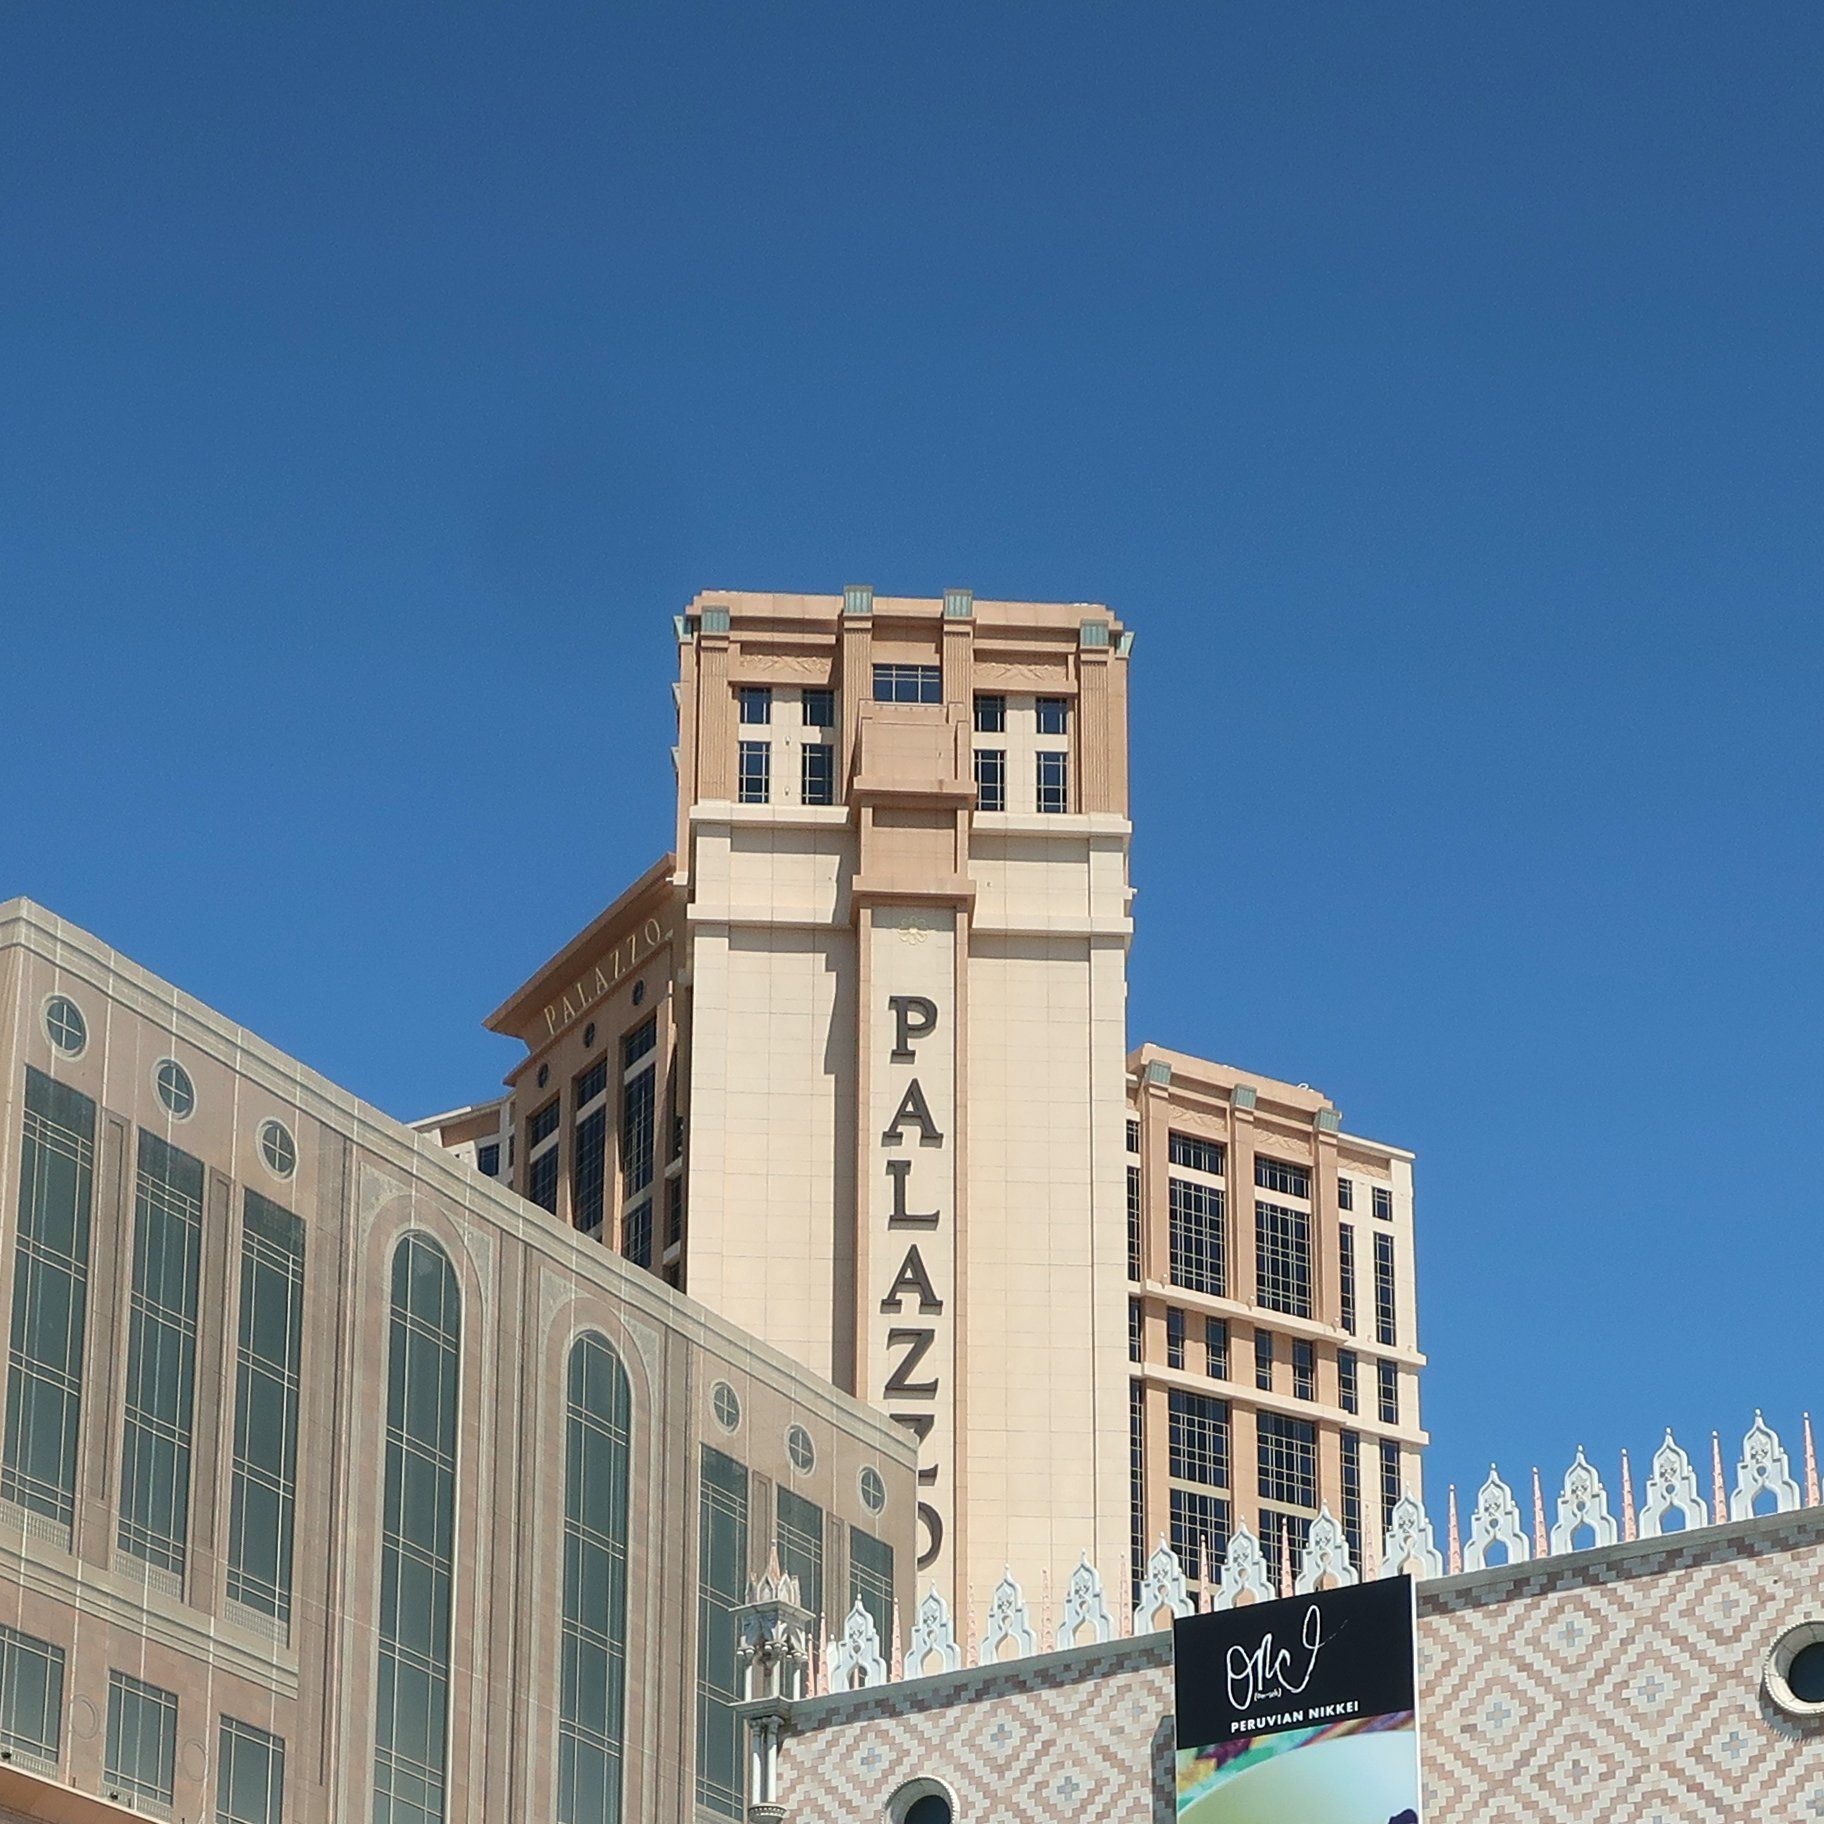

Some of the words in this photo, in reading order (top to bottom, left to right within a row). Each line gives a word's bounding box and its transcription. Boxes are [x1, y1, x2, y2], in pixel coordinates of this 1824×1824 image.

[543, 918, 661, 1036] PALAZZO
[1231, 1710, 1304, 1733] PERUVIAN
[1308, 1700, 1360, 1719] NIKKEI
